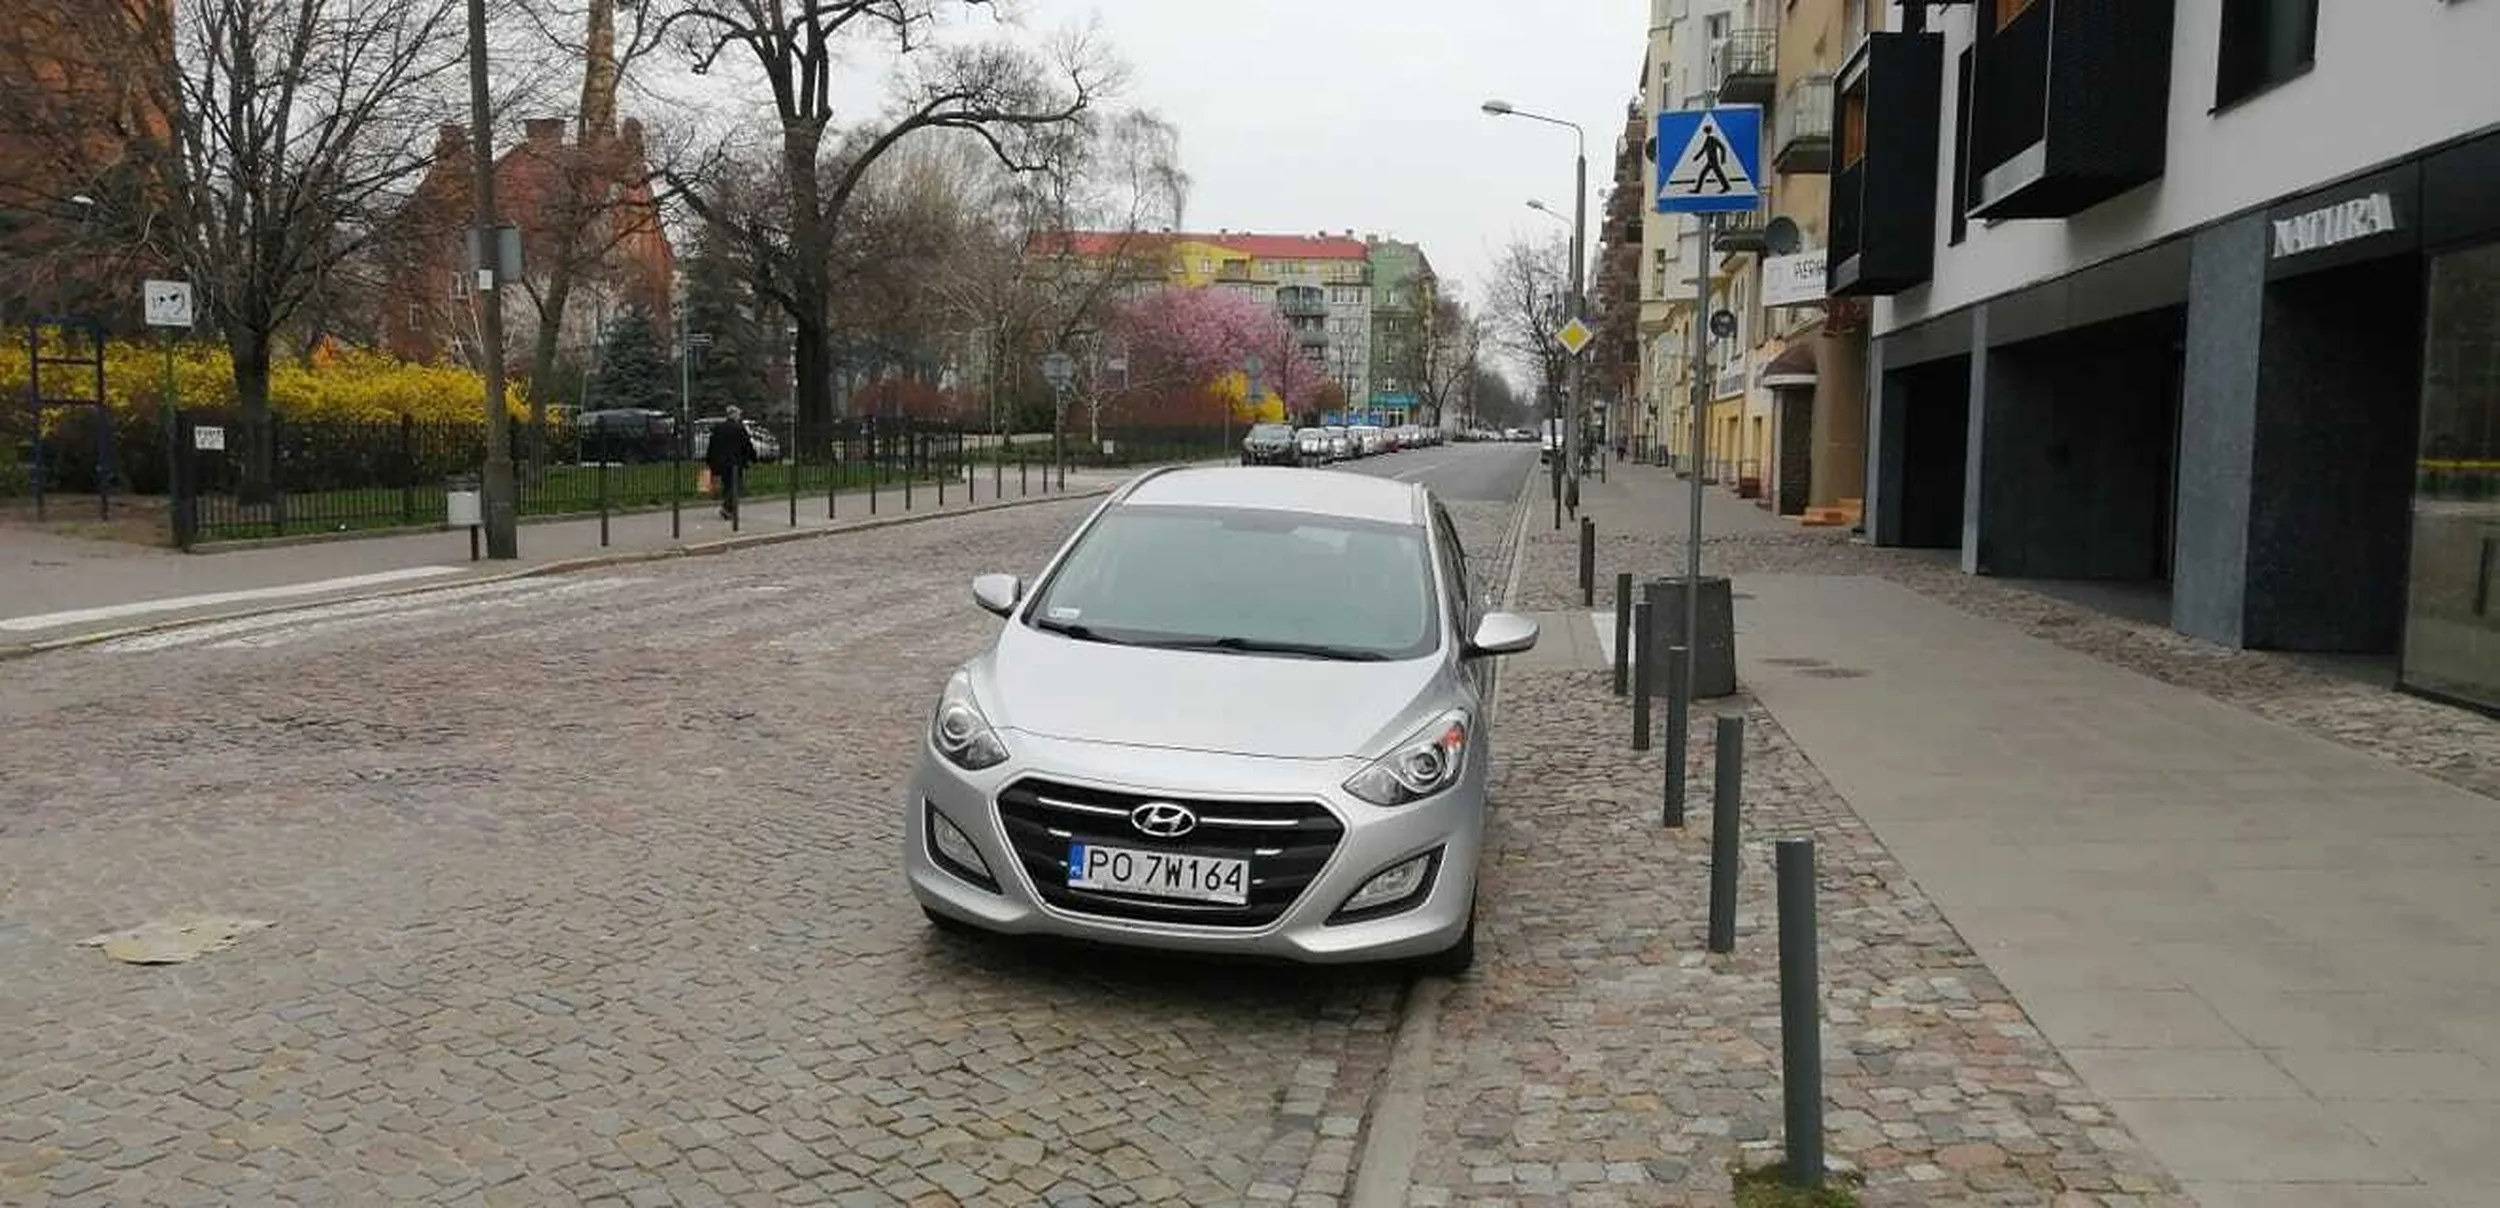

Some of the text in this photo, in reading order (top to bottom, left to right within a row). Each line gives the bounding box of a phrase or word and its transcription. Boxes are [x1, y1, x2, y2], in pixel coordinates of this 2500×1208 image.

[2272, 193, 2395, 258] NATURA
[1088, 850, 1242, 892] PO 7W164
